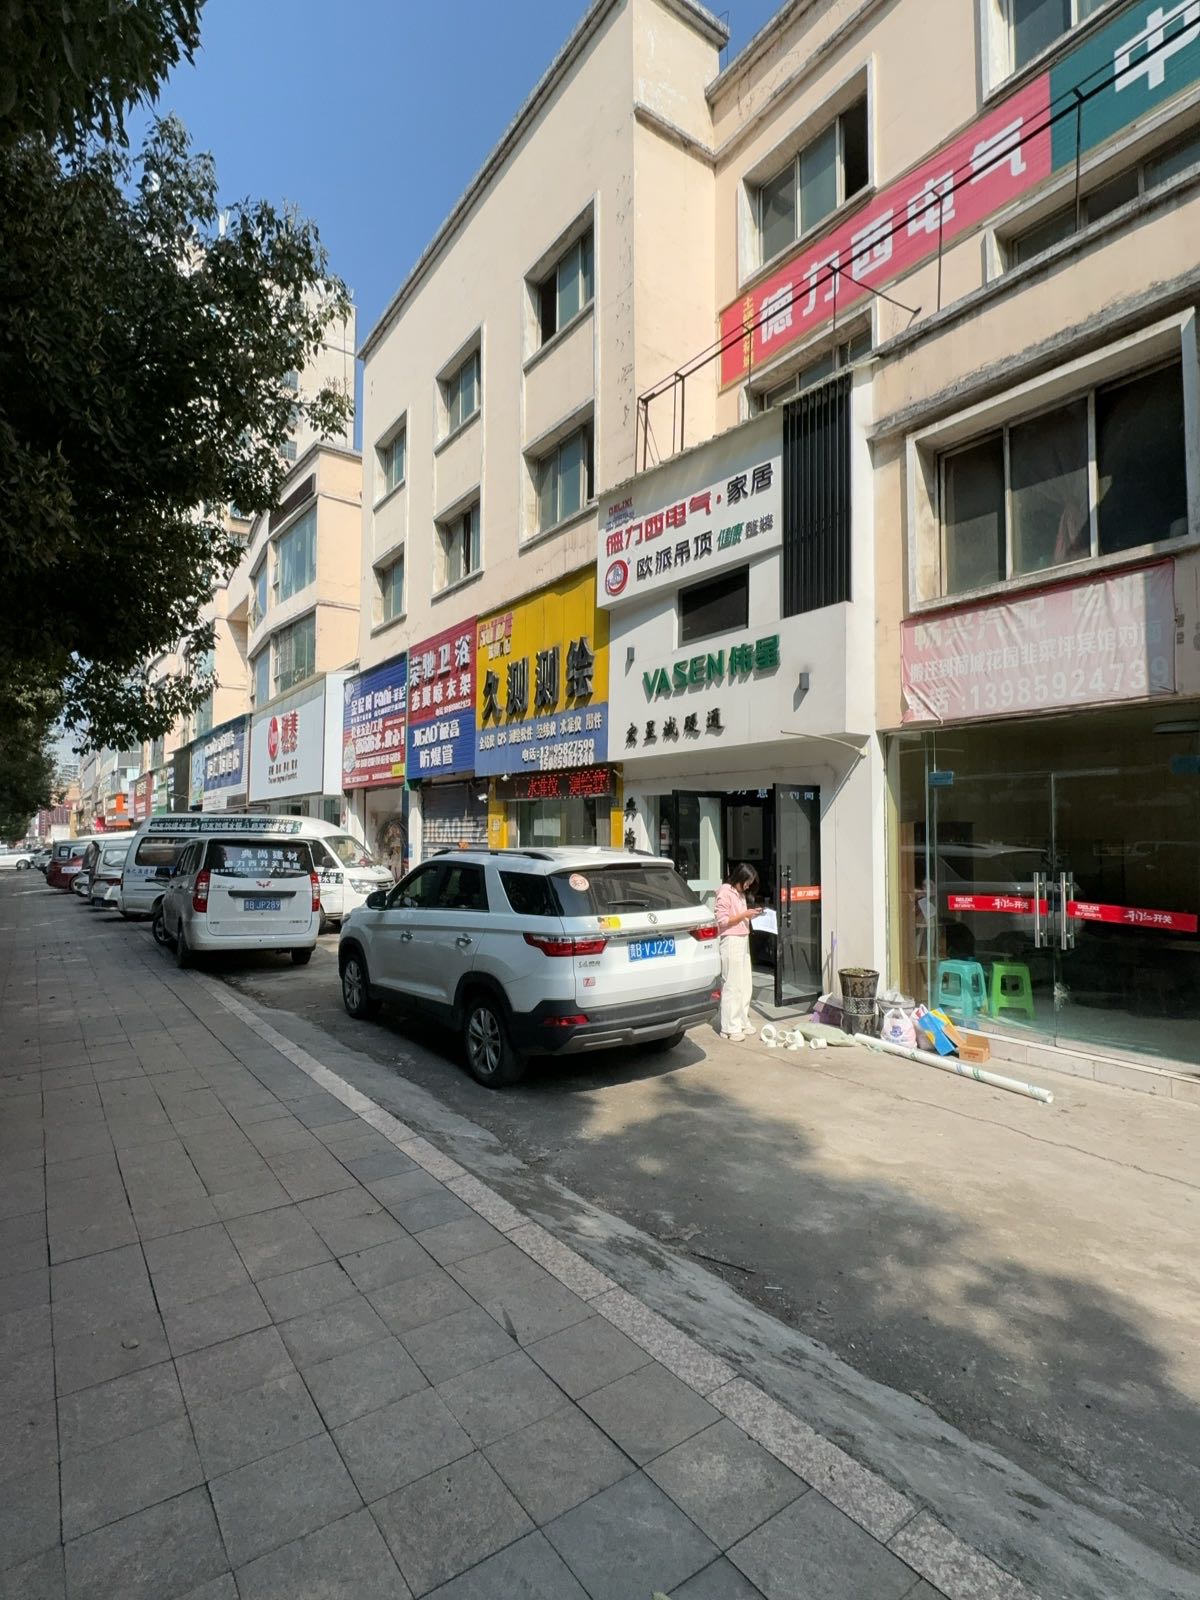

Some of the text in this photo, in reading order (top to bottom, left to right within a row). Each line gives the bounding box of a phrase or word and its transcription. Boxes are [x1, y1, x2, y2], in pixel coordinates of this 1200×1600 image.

[1114, 0, 1200, 93] 中
[760, 117, 1026, 345] 德力西电气
[643, 634, 780, 702] VASEN 伟星
[420, 744, 453, 768] 防爆管
